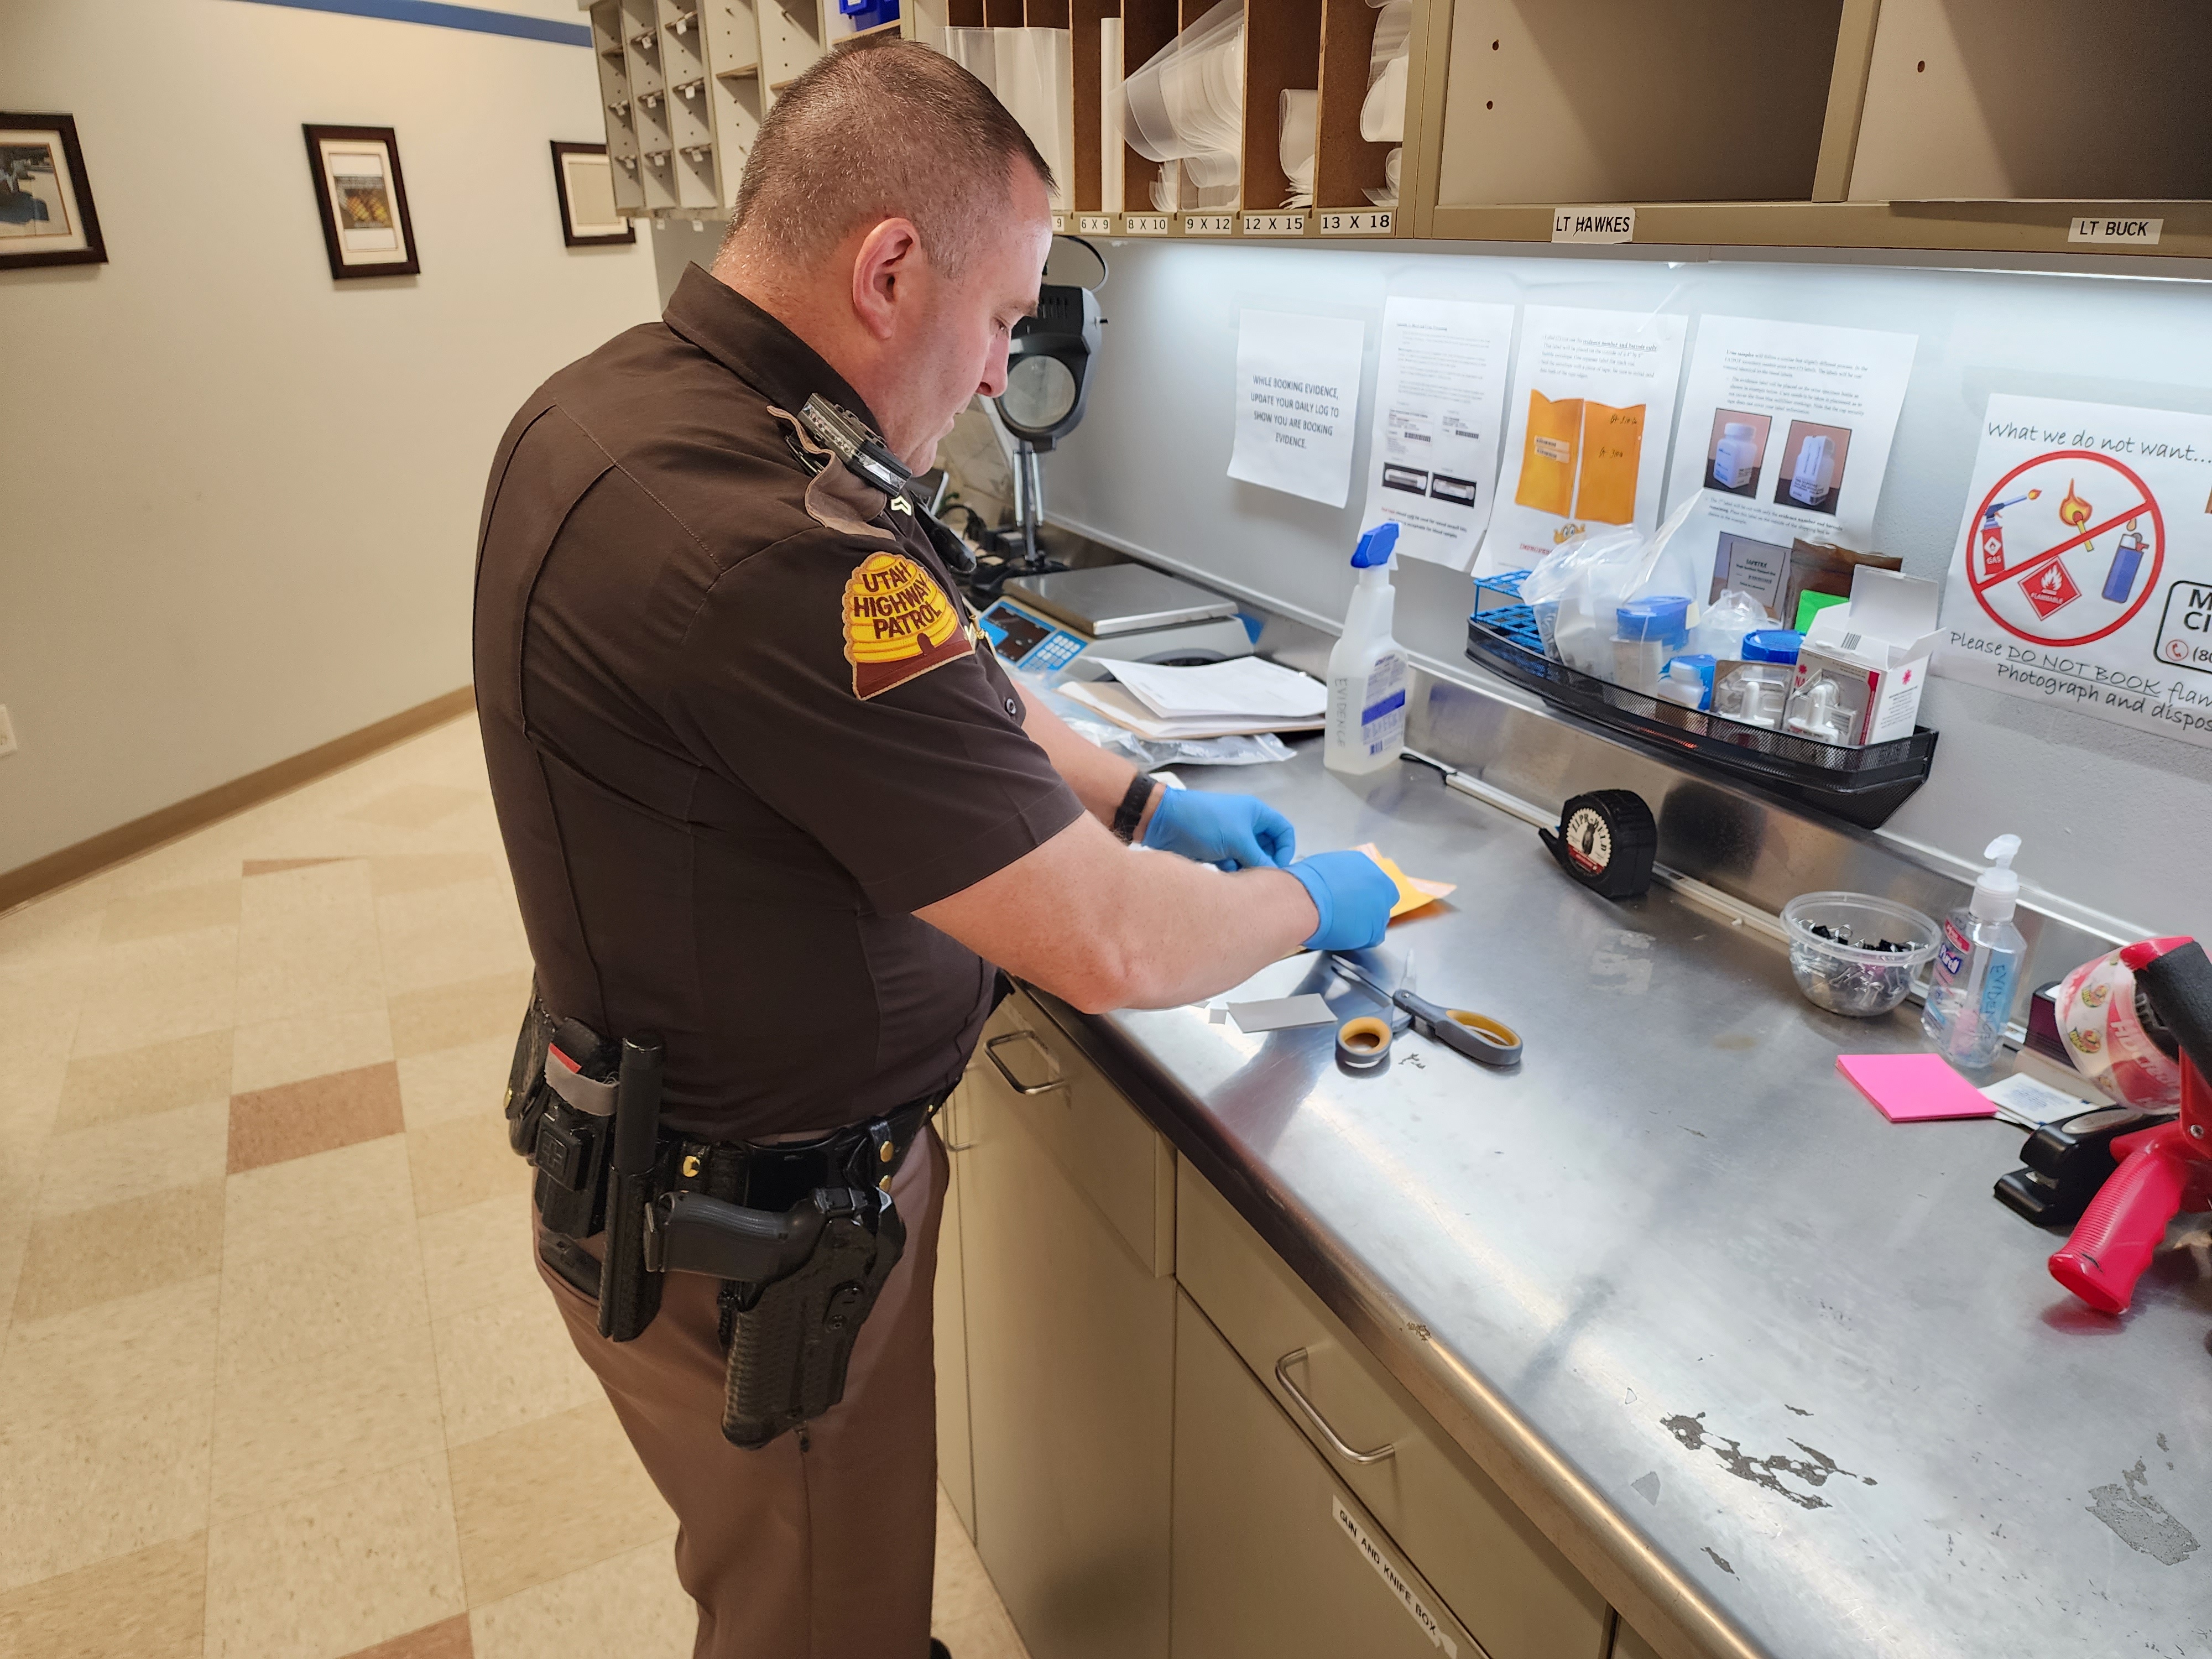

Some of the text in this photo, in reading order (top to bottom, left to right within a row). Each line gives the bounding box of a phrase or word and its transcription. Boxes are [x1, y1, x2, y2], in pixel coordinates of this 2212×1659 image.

[1057, 217, 1062, 227] 9
[1081, 220, 1109, 229] 6 X 9
[1128, 220, 1166, 229] 8 X 10
[1187, 218, 1230, 229] 9 X 12
[1245, 218, 1302, 229] 12 X 15
[1322, 215, 1390, 229] 13 X 18
[1556, 216, 1630, 232] LT HAWKES
[2079, 221, 2149, 236] LT BUCK
[1253, 375, 1339, 400] WHILE BOOKING EVIDENCE,
[1251, 392, 1339, 418] UPDATE YOUR DAILY LOG TO
[1254, 410, 1333, 436] SHOW YOU ARE BOOKING
[1275, 432, 1307, 449] EVIDENCE.
[1989, 421, 2038, 441] What
[2043, 430, 2065, 445] we
[2072, 430, 2094, 448] do
[2101, 436, 2135, 453] not
[1986, 555, 2001, 565] GAS
[862, 561, 912, 593] UTAH
[853, 573, 932, 618] HIGHWAY
[2030, 592, 2064, 604] FLAMMABLE
[873, 601, 942, 639] PATROL
[1951, 631, 2002, 656] Please
[2007, 645, 2036, 662] DO
[2043, 654, 2091, 676] NOT
[2095, 666, 2161, 695] BOOK
[1997, 664, 2099, 702] Photograph
[2106, 691, 2146, 713] and
[1335, 677, 1348, 748] EVIDENCE
[1340, 1509, 1436, 1636] GUN AND KNIFE BOX
